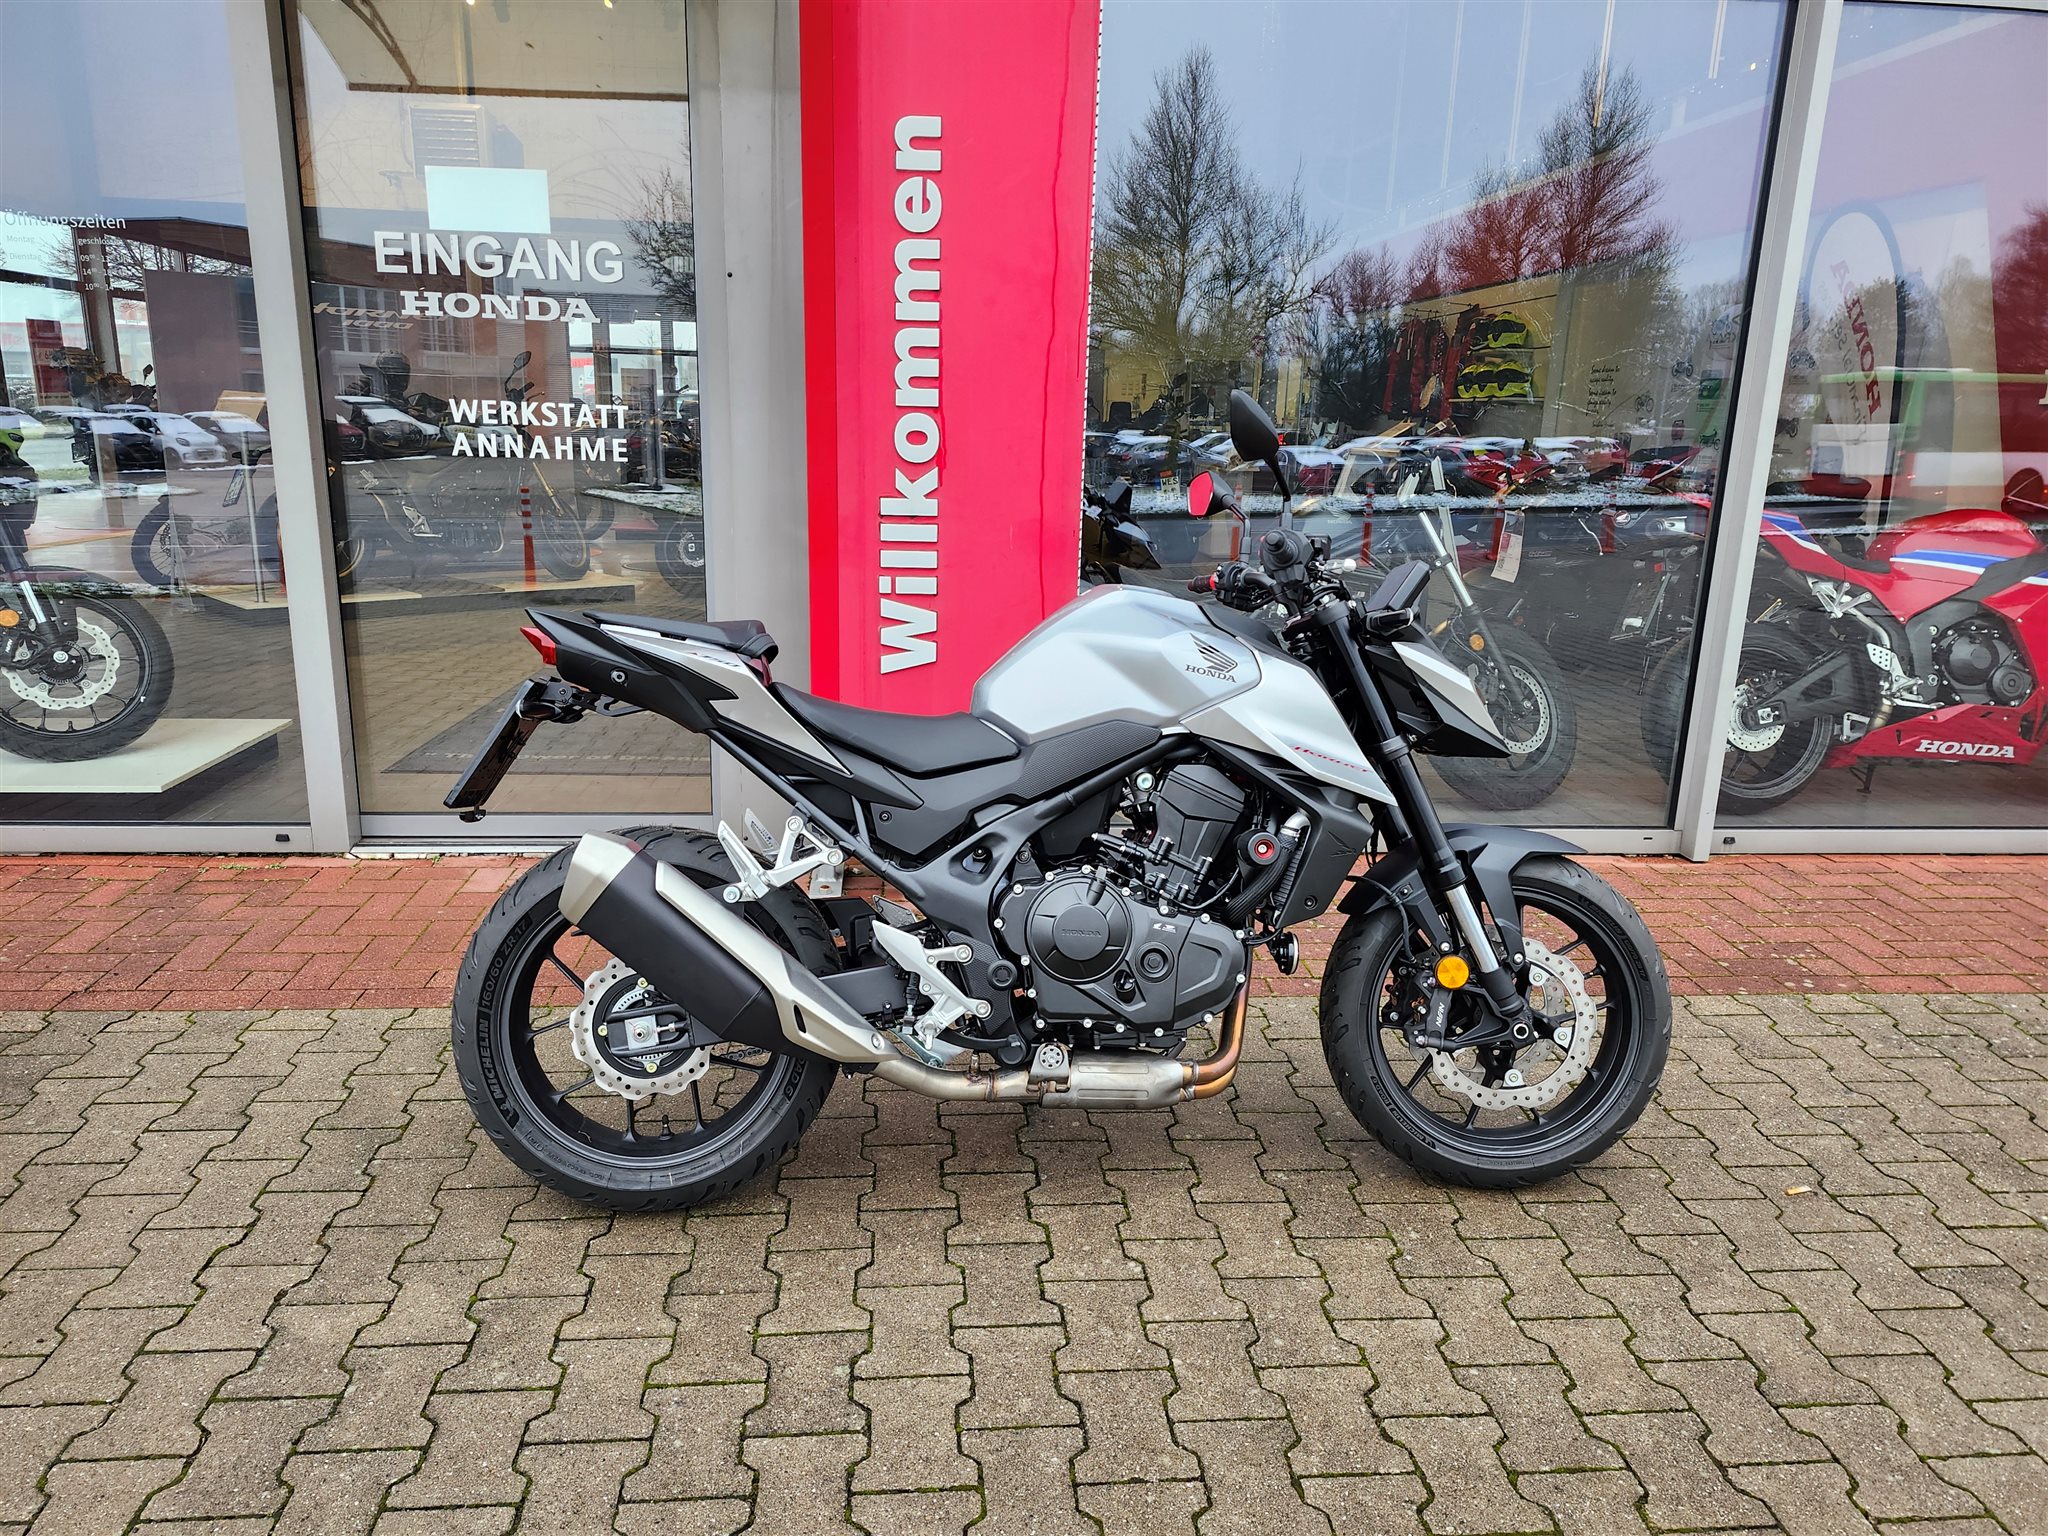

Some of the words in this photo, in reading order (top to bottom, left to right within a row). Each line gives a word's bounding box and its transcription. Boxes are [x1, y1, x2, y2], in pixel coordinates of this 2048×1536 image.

[4, 208, 126, 231] Öffnungszeiten
[373, 230, 625, 284] EINGANG
[399, 290, 600, 324] HONDA
[879, 114, 943, 674] Willkommen
[449, 398, 629, 429] WERKSTATT
[451, 433, 629, 463] ANNAHME
[1185, 664, 1237, 683] HONDA
[1915, 739, 2015, 758] HONDA
[1061, 928, 1102, 938] HONDA
[482, 957, 503, 1008] 160/60
[503, 935, 517, 954] ZR
[516, 922, 528, 936] 17
[479, 1017, 506, 1100] MICHELIN
[1392, 1109, 1425, 1140] MICHELIN
